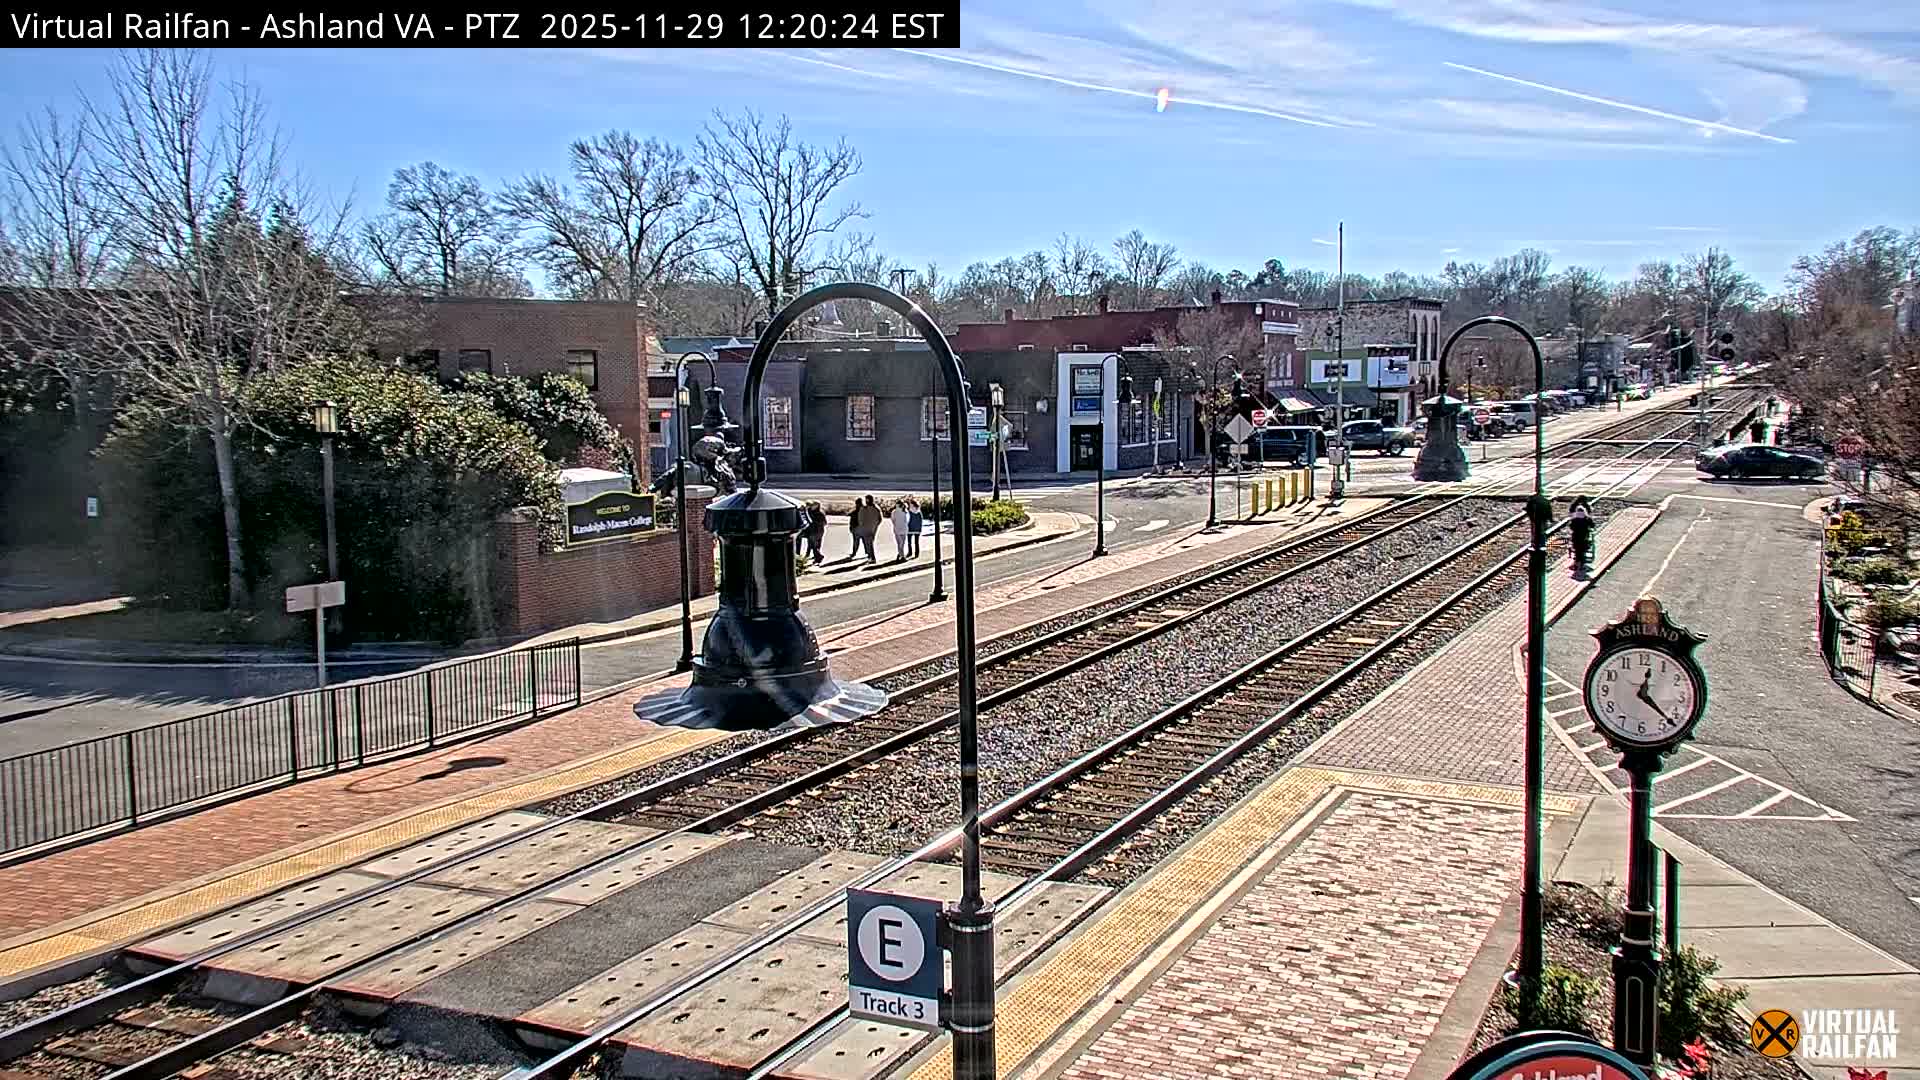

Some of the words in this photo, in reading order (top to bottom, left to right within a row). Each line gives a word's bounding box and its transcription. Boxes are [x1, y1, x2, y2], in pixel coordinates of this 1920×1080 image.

[1837, 443, 1861, 454] STOP
[1615, 624, 1679, 641] ASHLAND
[1621, 656, 1631, 670] 11
[1639, 653, 1651, 666] 12
[1661, 660, 1666, 673] 1
[1605, 669, 1618, 681] 10
[1673, 673, 1681, 687] 2
[1601, 684, 1609, 697] 9
[1678, 690, 1686, 703] 3
[1606, 701, 1615, 713] 8
[1672, 706, 1680, 720] 4
[1618, 715, 1627, 729] 7
[1637, 721, 1646, 734] 6
[1658, 719, 1667, 731] 5
[879, 918, 903, 968] E
[860, 992, 908, 1017] Track
[914, 1001, 924, 1020] 3
[1511, 1064, 1602, 1080] land
